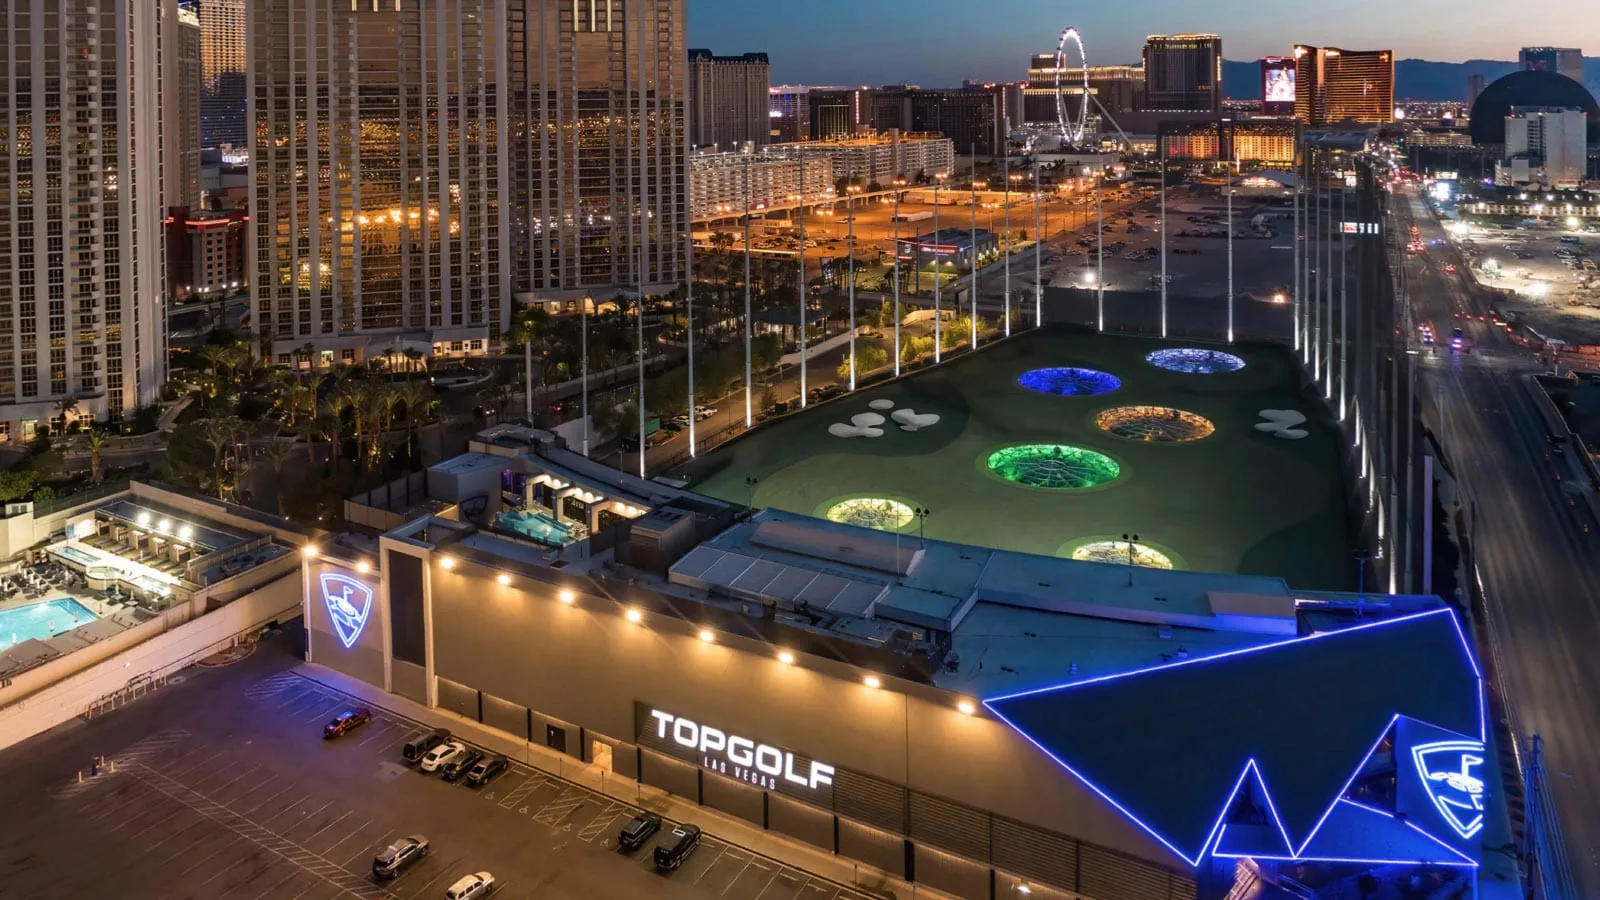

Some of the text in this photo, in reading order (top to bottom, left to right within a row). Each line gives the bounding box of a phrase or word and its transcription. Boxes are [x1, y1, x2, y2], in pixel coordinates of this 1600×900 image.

[651, 708, 835, 790] TOPGOLF
[704, 756, 775, 790] LAS VEGAS
